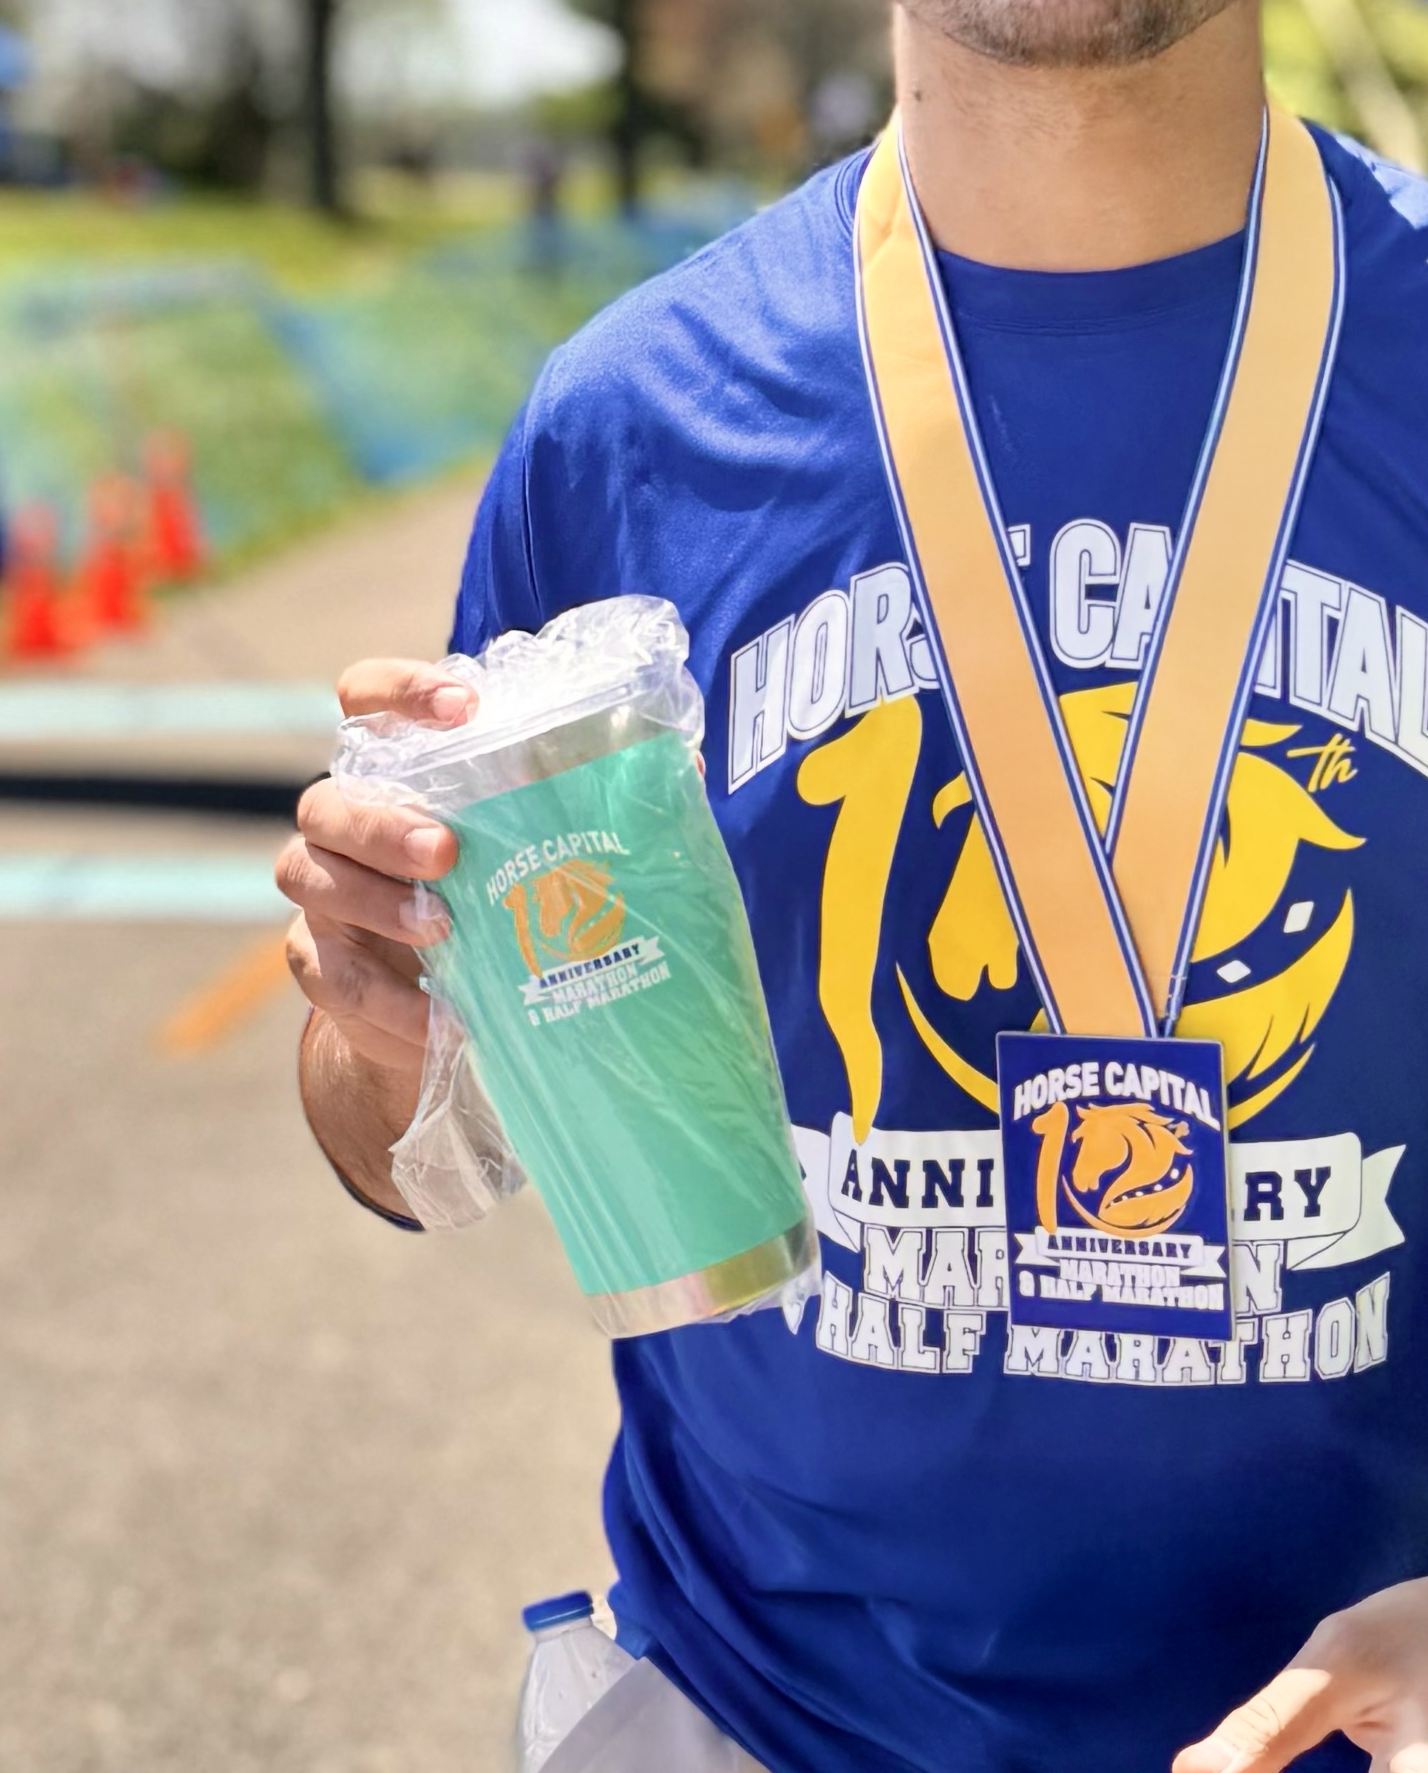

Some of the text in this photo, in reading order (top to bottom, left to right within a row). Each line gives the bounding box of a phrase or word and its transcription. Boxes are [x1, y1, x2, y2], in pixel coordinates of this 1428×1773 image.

[728, 524, 1031, 795] HOR
[486, 831, 630, 906] HORSE CAPITAL
[539, 942, 640, 989] ANNIVERSARY
[542, 1001, 581, 1023] HALF
[587, 961, 671, 1009] MARATHON
[550, 963, 637, 1004] MARATHON
[1013, 1061, 1221, 1131] HORSE CAPITAL
[841, 1148, 1331, 1222] ANNIRY
[863, 1223, 1284, 1317] MARN
[1047, 1234, 1192, 1259] ANNIVERSARY
[1059, 1258, 1180, 1287] MARATHON
[1040, 1275, 1098, 1301] HALF
[1102, 1284, 1225, 1311] MARATHON
[816, 1270, 987, 1374] HALF
[1003, 1272, 1390, 1386] MARATHON
